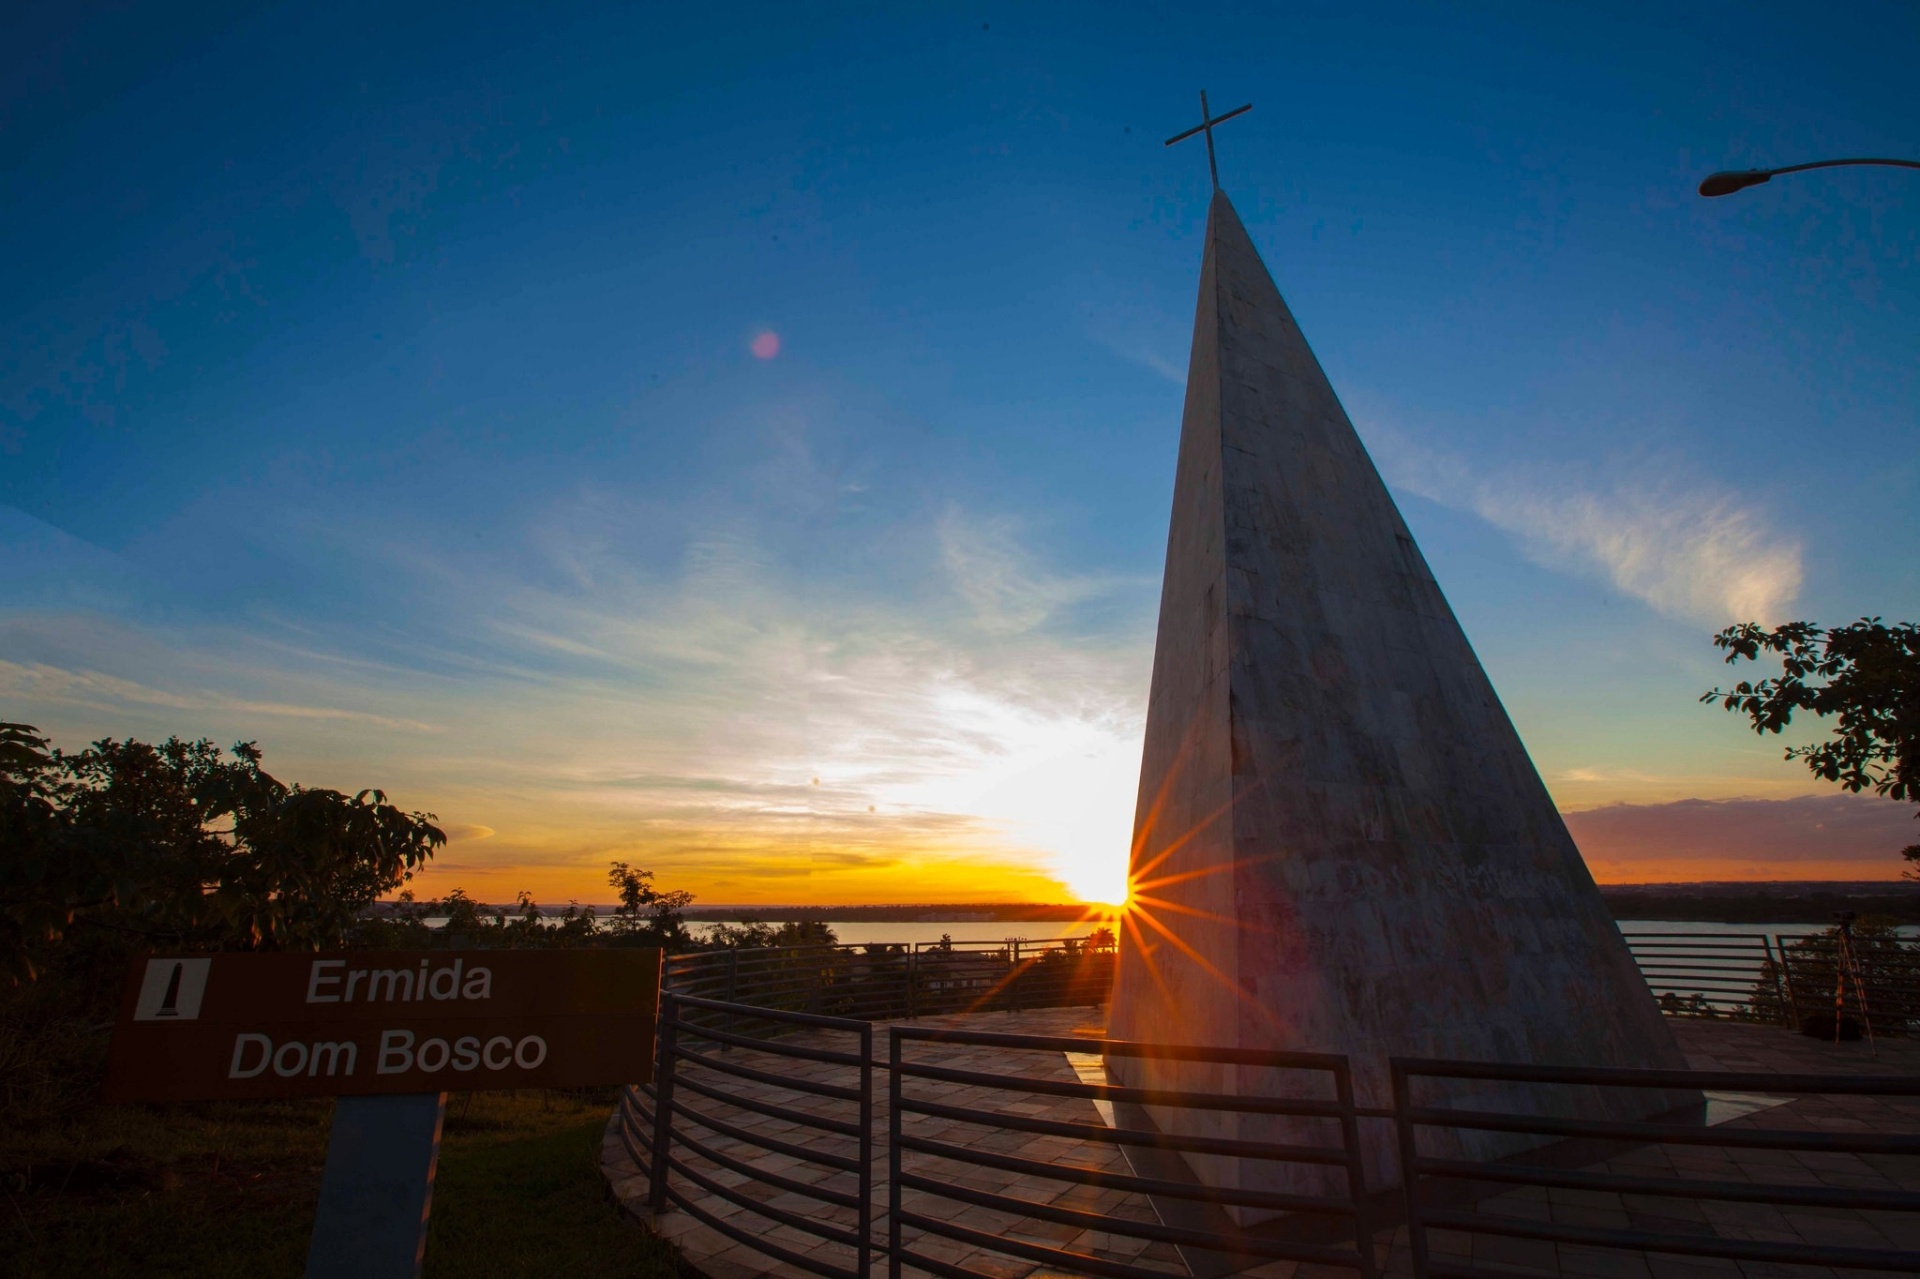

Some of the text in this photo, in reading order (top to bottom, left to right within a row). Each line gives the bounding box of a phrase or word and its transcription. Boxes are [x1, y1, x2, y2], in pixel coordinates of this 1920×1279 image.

[306, 958, 493, 1003] Ermida
[228, 1029, 548, 1079] Dom Bosco
